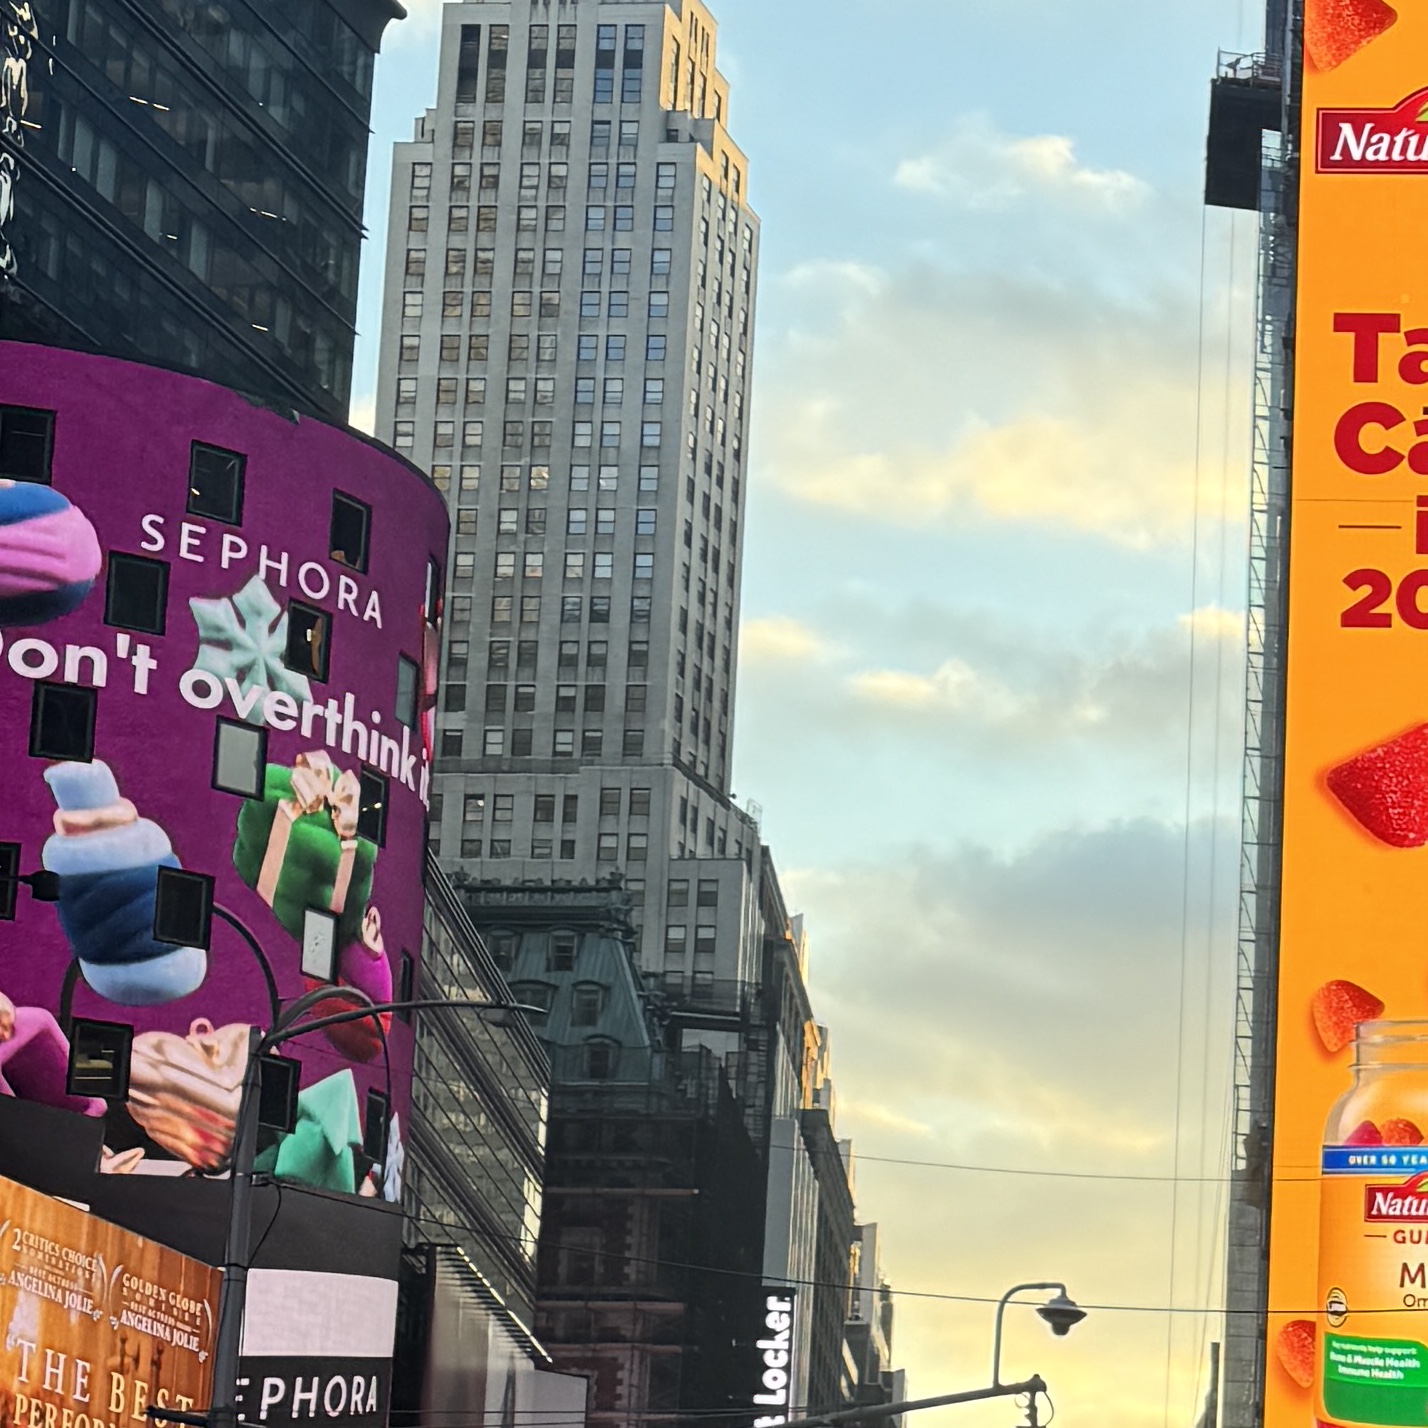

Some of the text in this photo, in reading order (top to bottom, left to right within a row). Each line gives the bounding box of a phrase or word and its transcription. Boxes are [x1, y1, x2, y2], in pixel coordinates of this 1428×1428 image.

[140, 513, 383, 629] SEPHORA
[0, 629, 158, 695] on't
[179, 668, 416, 792] overthink
[1349, 1155, 1376, 1165] OVER
[12, 1228, 21, 1251] 2
[22, 1230, 60, 1257] CRITICS
[61, 1247, 98, 1272] CHOICE
[8, 1270, 94, 1315] ANGELINA JOLIE
[122, 1273, 203, 1315] GOLDEN GLOBE
[120, 1309, 171, 1341] ANGELINA
[171, 1328, 200, 1351] JOLIE
[235, 1375, 377, 1421] EPHORA
